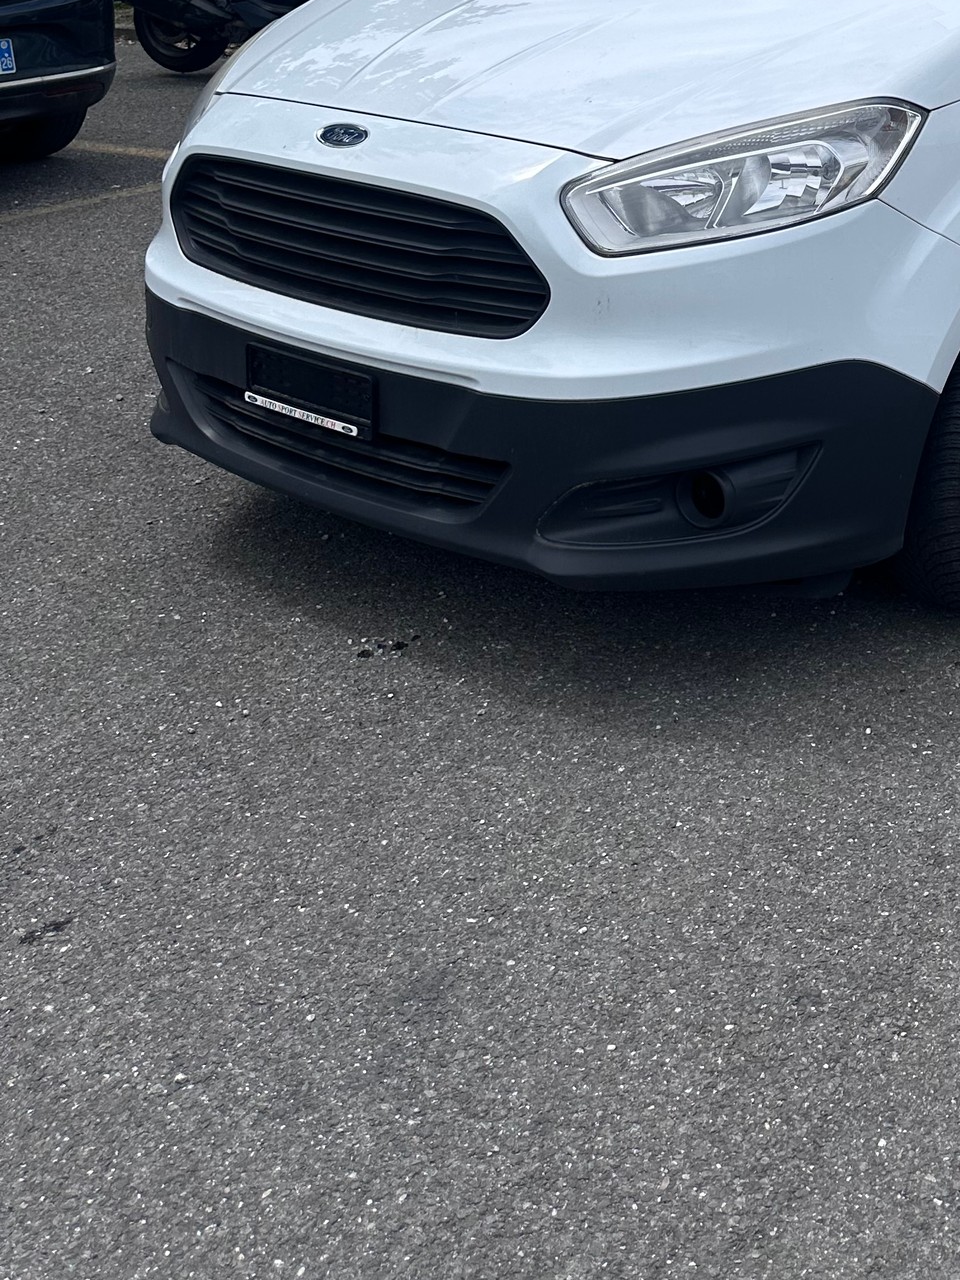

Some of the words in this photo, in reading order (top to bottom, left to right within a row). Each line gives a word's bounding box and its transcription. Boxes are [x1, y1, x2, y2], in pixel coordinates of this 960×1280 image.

[323, 126, 362, 144] Ford
[261, 399, 277, 409] AUTO
[278, 403, 297, 417] SPORT
